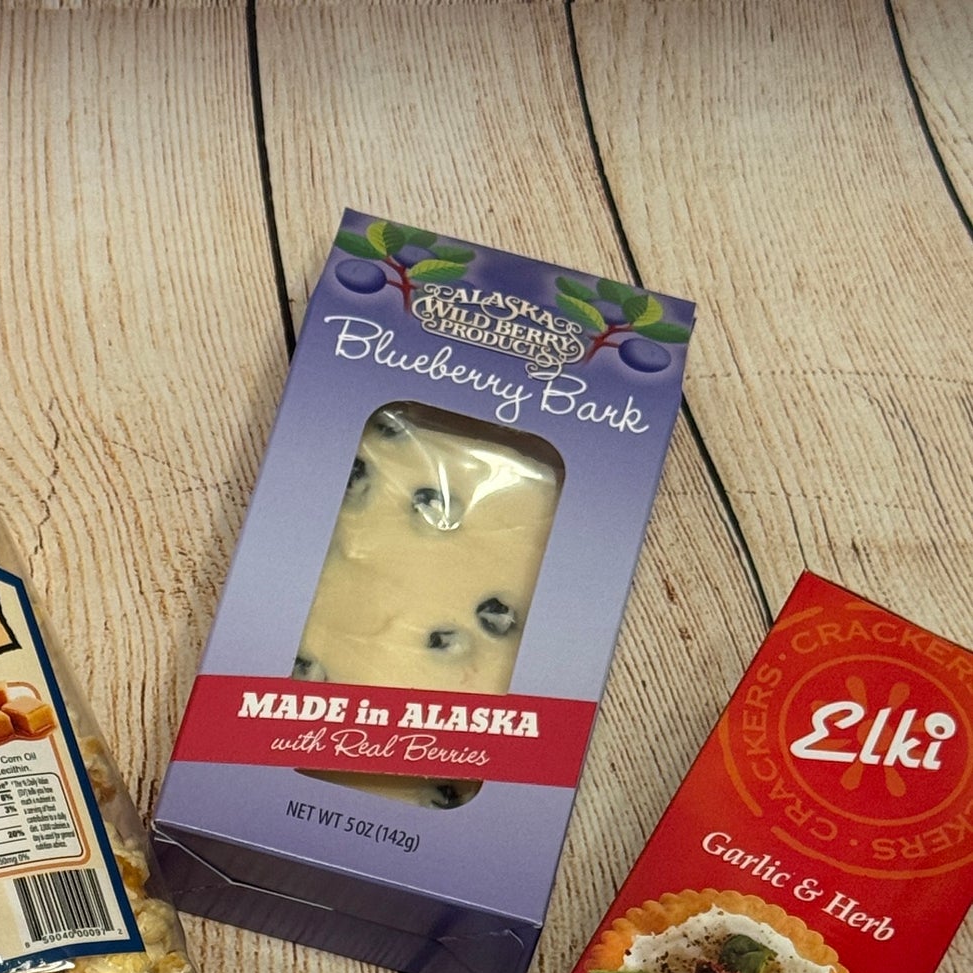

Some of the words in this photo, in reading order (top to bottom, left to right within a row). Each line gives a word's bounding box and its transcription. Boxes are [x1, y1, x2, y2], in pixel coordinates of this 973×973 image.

[427, 297, 497, 327] WILD
[495, 320, 573, 356] BERRY
[434, 285, 570, 333] ALASKA
[438, 320, 551, 364] PRODUCTS
[324, 316, 532, 423] Blueberry
[528, 371, 649, 434] Bark
[791, 619, 973, 695] CRACKER
[237, 692, 349, 723] MADE
[355, 699, 389, 726] in
[398, 702, 539, 737] ALASKA
[790, 700, 956, 770] Elki
[0, 754, 22, 765] Corn
[24, 752, 37, 761] Oil
[271, 727, 326, 752] with
[330, 728, 402, 758] Real
[399, 734, 490, 766] Berries
[742, 662, 838, 842] CRACKERS
[286, 800, 316, 822] NET
[318, 810, 343, 829] WT
[344, 817, 355, 833] 5
[355, 820, 375, 838] OZ
[375, 824, 420, 853] (142g)
[871, 798, 973, 861] KERS
[702, 831, 791, 888] Garlic
[794, 878, 824, 901] &
[822, 891, 896, 941] Herb
